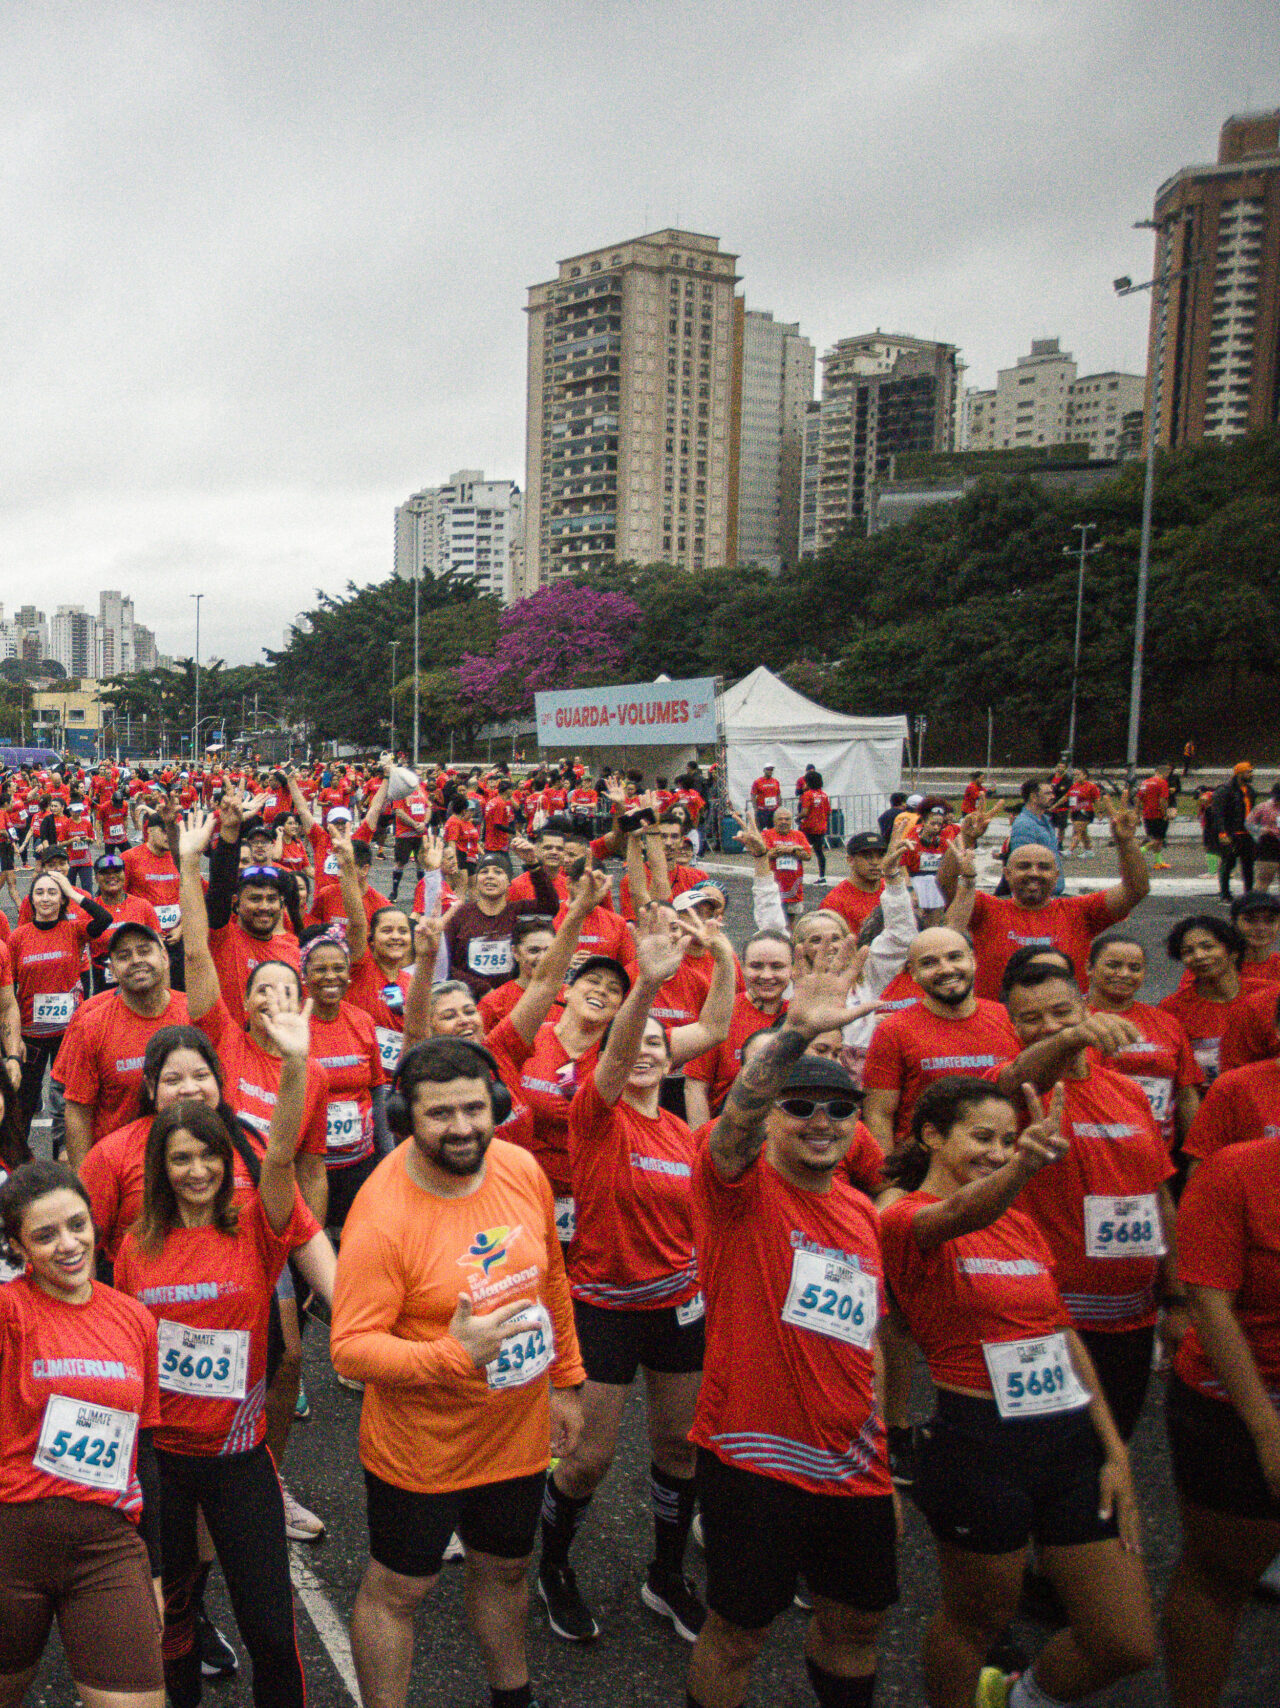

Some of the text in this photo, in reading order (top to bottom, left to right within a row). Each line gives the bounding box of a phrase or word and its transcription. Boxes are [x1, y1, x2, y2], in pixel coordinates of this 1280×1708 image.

[555, 700, 689, 728] GUARDA-VOLUMES
[474, 954, 507, 966] 5785
[38, 1005, 68, 1016] 5728
[798, 1283, 864, 1325] 5206
[183, 1330, 216, 1346] CLIMATE
[497, 1330, 546, 1372] 5342
[32, 1357, 126, 1380] CLIMATERUN
[162, 1348, 231, 1381] 5603
[1005, 1365, 1065, 1399] 5689
[77, 1407, 113, 1427] CLIMATE
[49, 1430, 120, 1469] 5425
